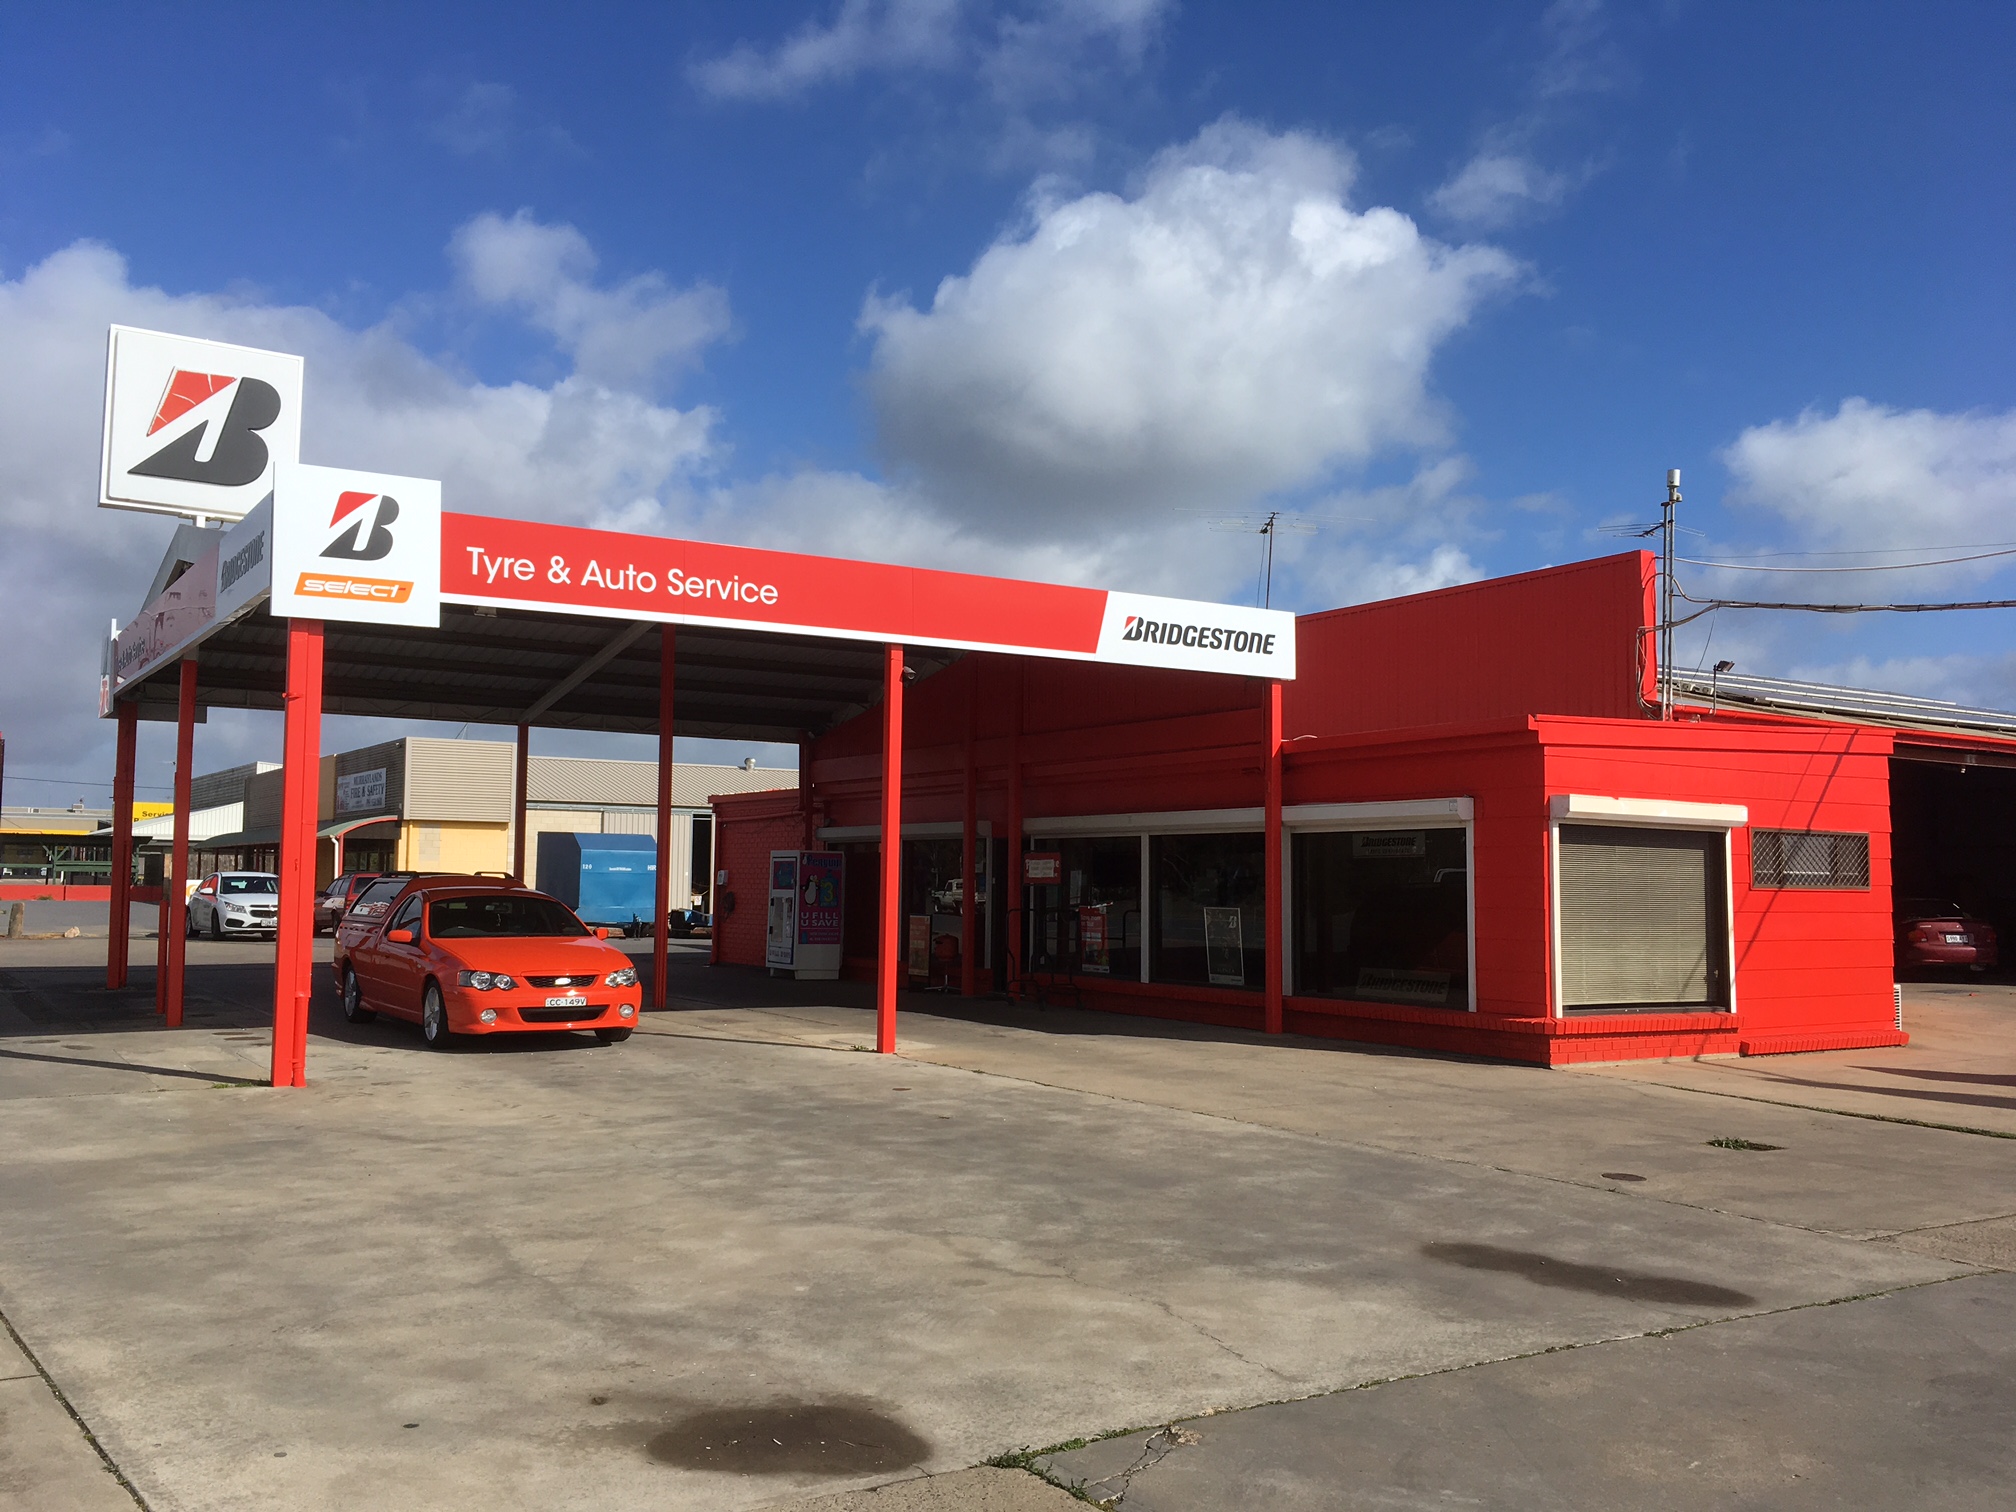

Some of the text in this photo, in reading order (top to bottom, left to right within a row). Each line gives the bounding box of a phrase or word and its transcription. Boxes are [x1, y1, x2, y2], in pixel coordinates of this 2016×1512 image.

[220, 530, 265, 594] BRIDGESTONE
[466, 546, 780, 605] Tyre & Auto Service
[1122, 615, 1277, 655] BRIDGESTONE
[351, 786, 361, 799] FIRE
[367, 783, 385, 797] SAFETY
[1361, 836, 1417, 848] BRIDGESTONE
[801, 912, 839, 920] U FILL
[812, 919, 839, 927] SAVE
[1359, 973, 1448, 995] BRIDGESTONE
